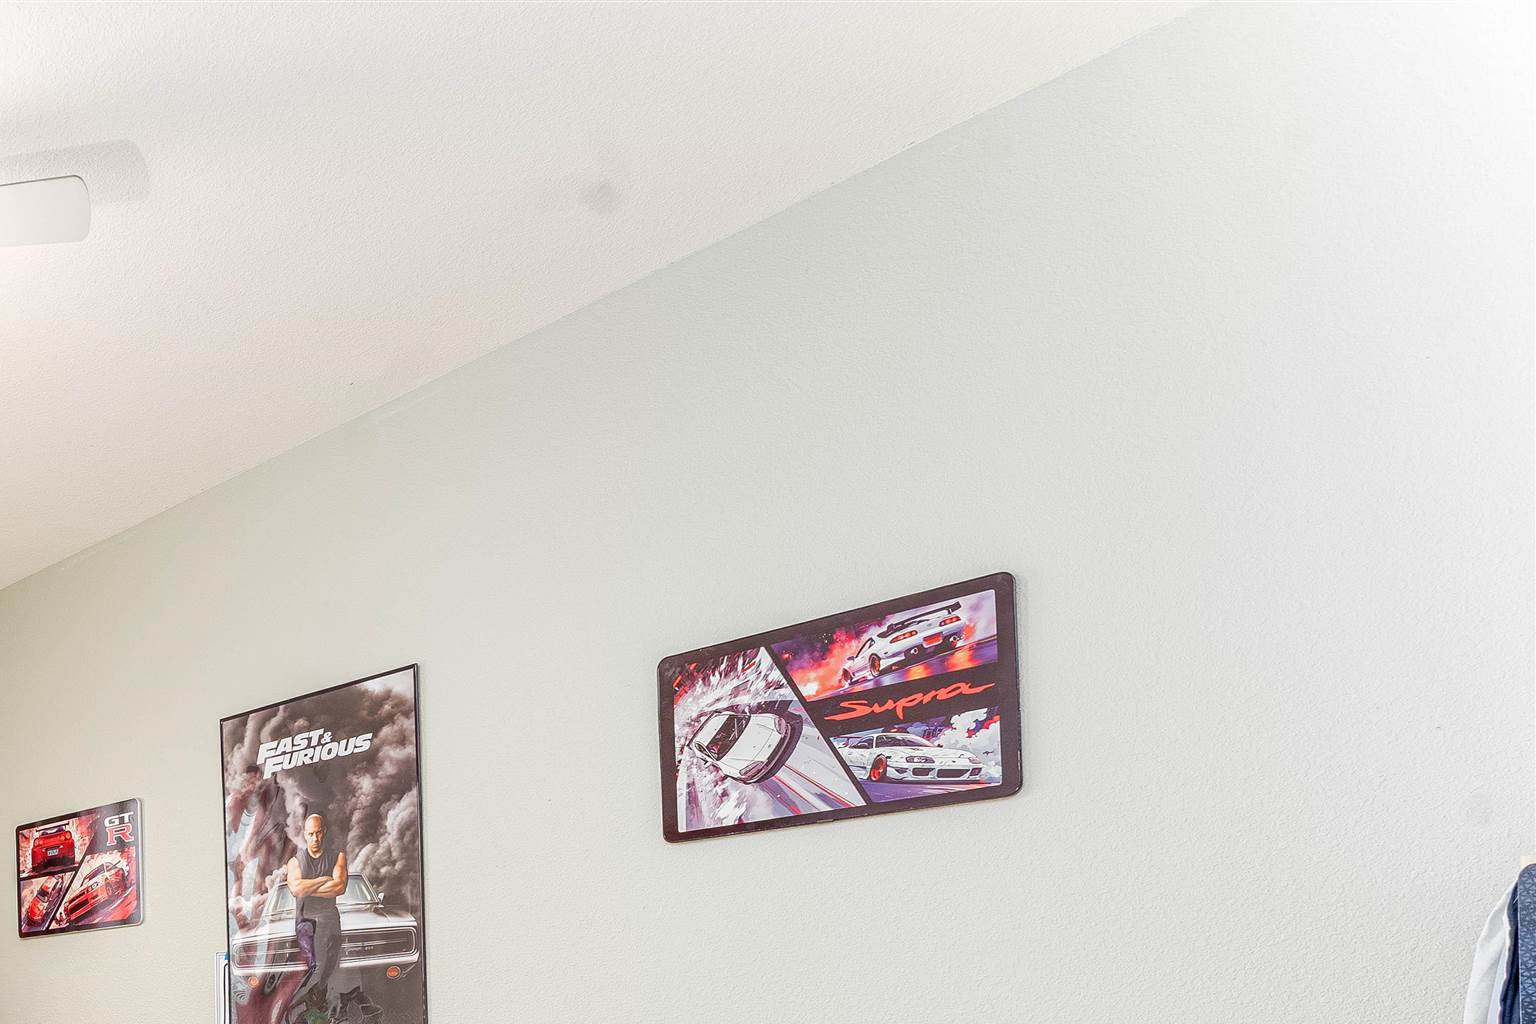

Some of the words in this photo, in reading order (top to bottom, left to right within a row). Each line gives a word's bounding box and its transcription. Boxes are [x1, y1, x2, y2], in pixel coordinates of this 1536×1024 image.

[824, 683, 995, 719] Supra
[257, 728, 324, 765] FAST
[321, 731, 332, 744] &
[263, 733, 373, 779] FURIOUS
[104, 812, 134, 827] GT
[106, 824, 135, 846] R
